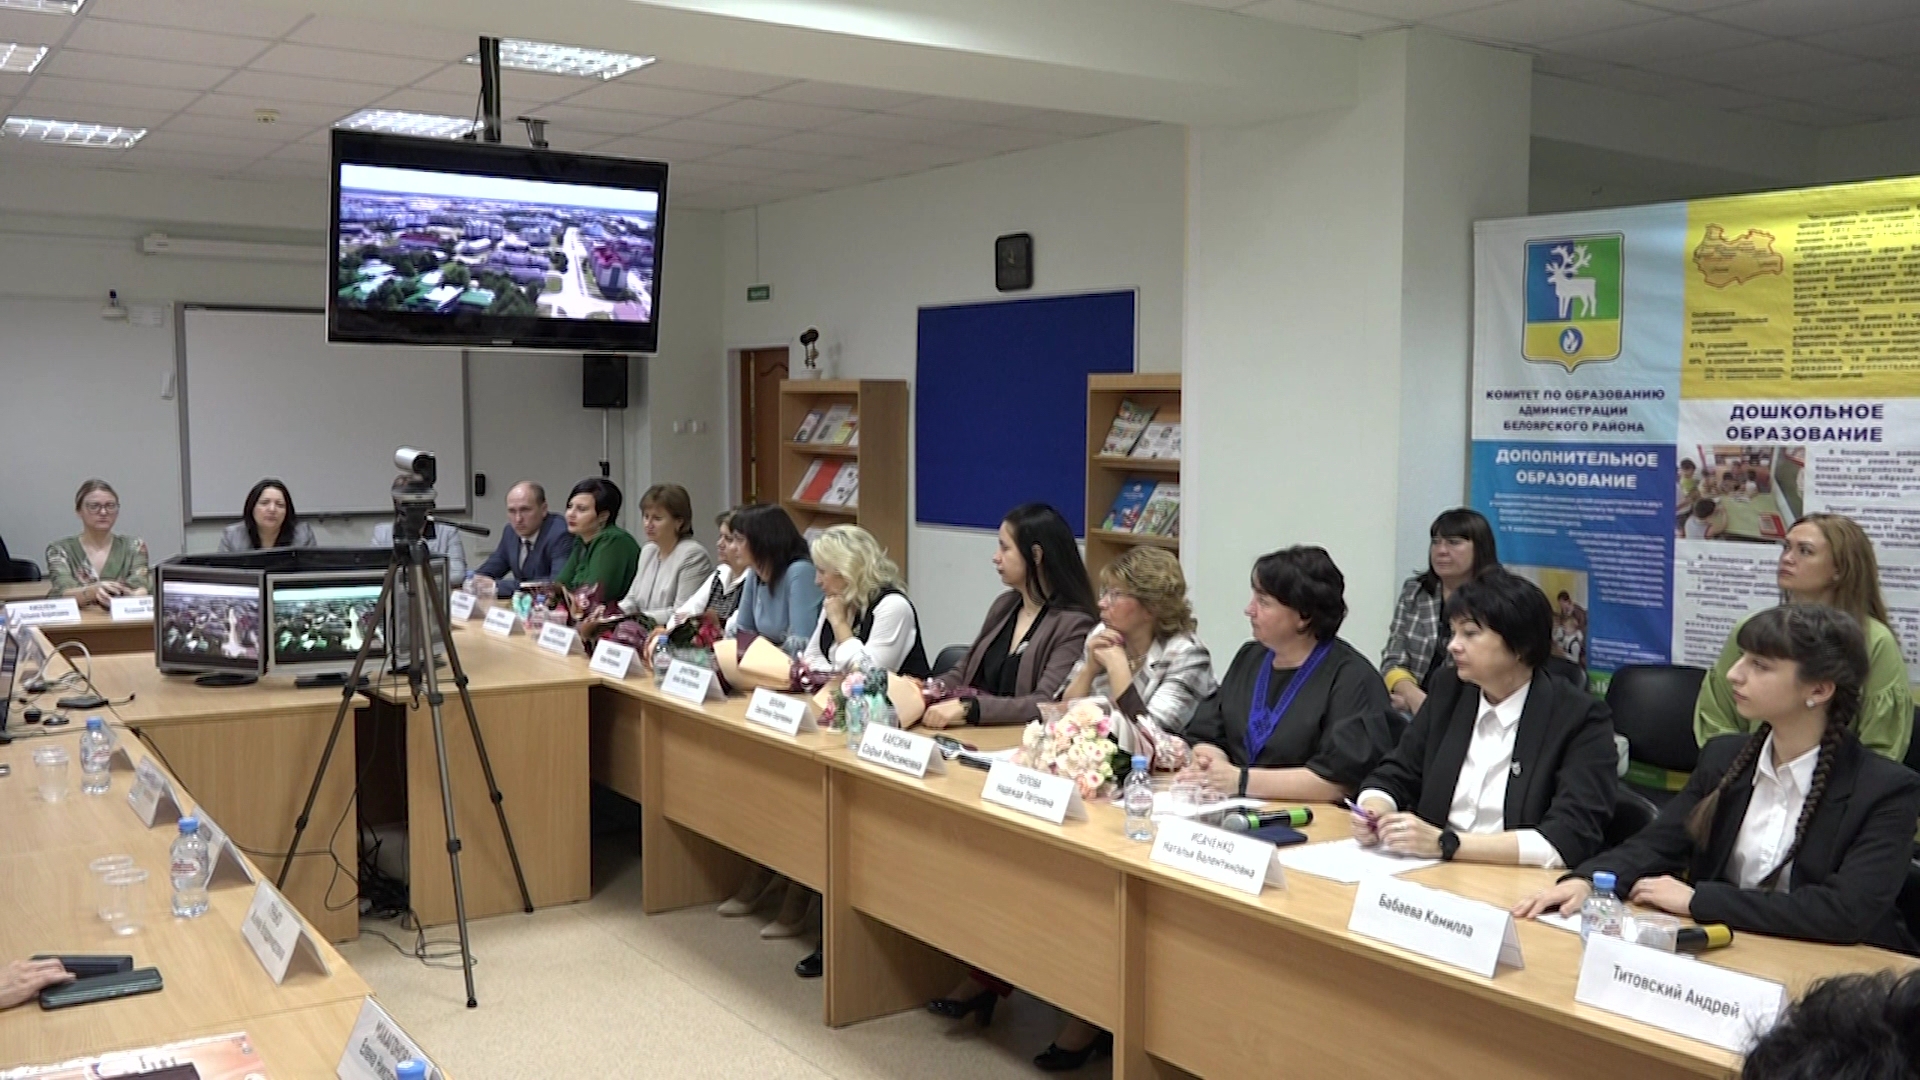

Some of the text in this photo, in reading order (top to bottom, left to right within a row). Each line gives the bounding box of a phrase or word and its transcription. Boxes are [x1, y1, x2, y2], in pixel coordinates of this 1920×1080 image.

[1486, 389, 1665, 400] КОМИТЕТ ПО ОБРАЗОВАНИЮ
[1518, 406, 1628, 417] АДМИНИСТРАЦИИ
[1730, 403, 1884, 421] ДОШКОЛЬНОЕ
[1503, 420, 1645, 432] БЕЛОЯРСКОГО РАЙОНА
[1726, 426, 1882, 442] ОБРАЗОВАНИЕ
[1495, 449, 1659, 467] ДОПОЛНИТЕЛЬНОЕ
[1516, 470, 1637, 489] ОБРАЗОВАНИЕ
[1191, 832, 1235, 854] ИСАЧЕНКО
[1163, 841, 1256, 879] Наталья Валентиновна
[1379, 893, 1474, 938] Бабаева Камилла
[1613, 964, 1740, 1019] Титовский Андрей
